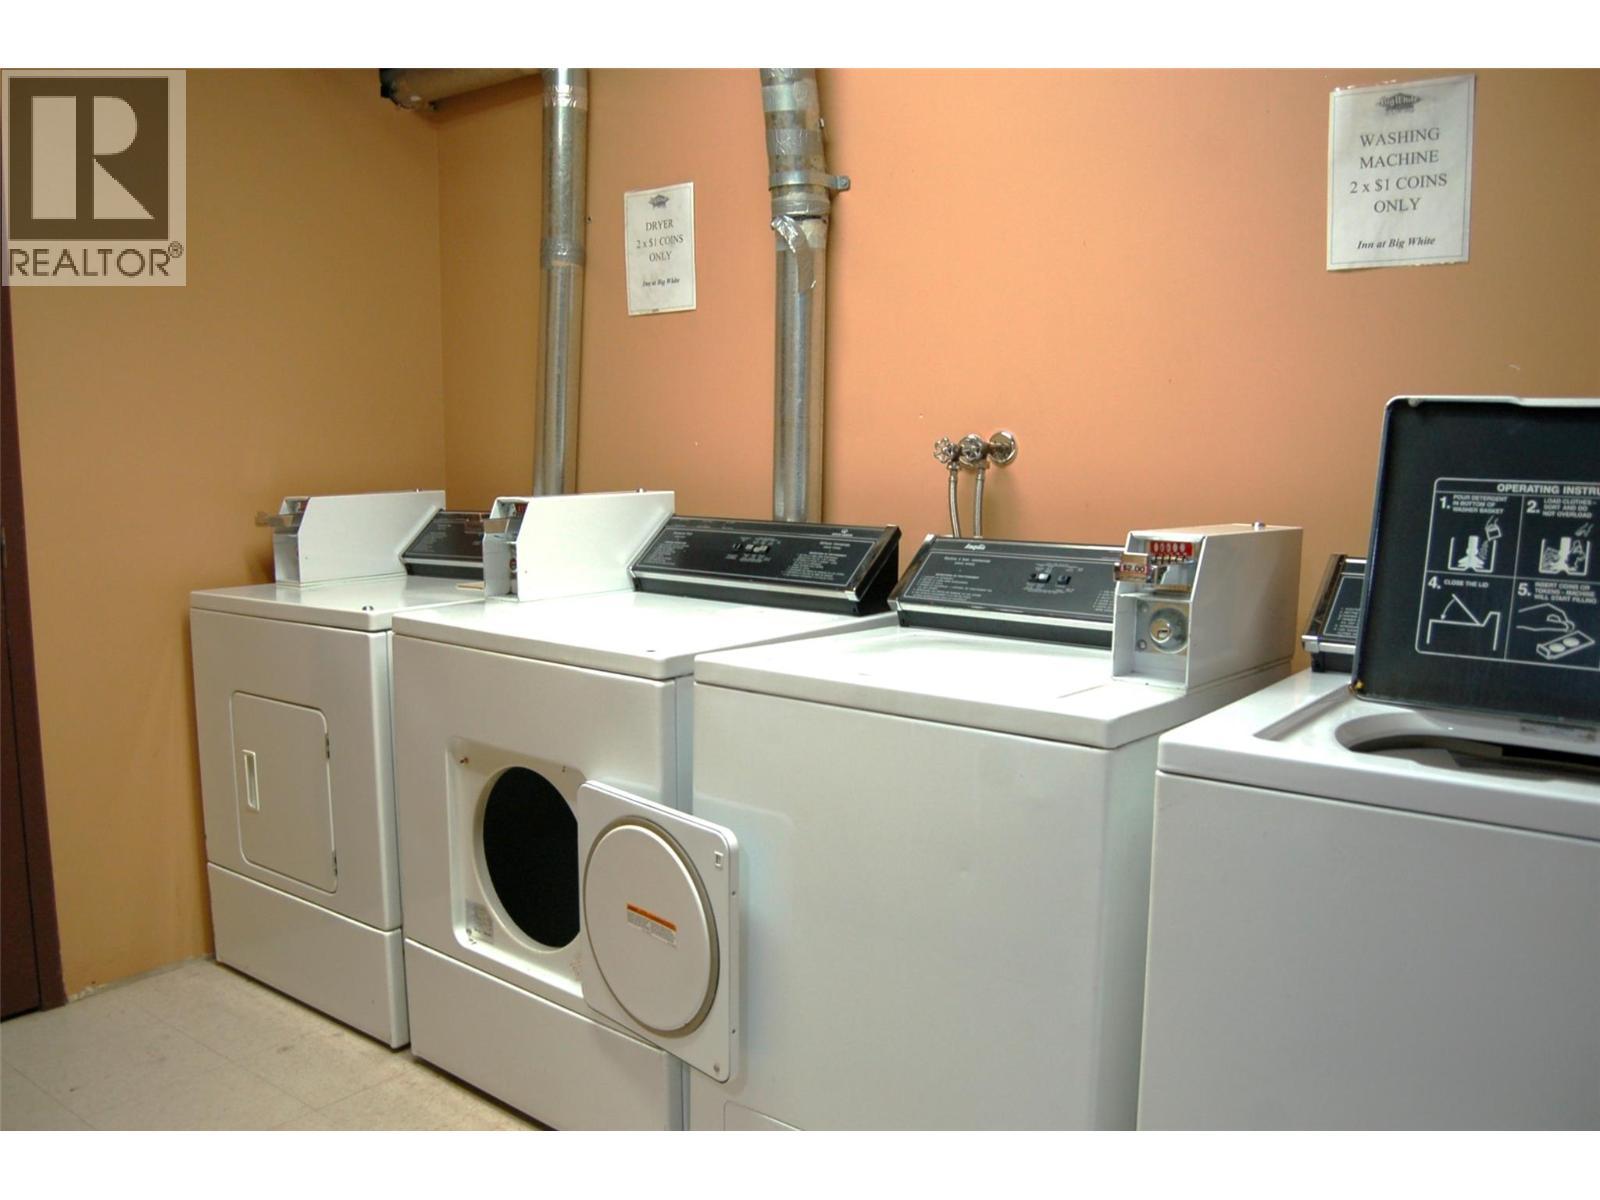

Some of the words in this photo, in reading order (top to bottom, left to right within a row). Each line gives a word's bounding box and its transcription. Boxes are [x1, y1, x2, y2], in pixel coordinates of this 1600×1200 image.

[1359, 127, 1441, 147] WASHING
[1359, 150, 1440, 169] MACHINE
[1349, 181, 1359, 194] 2
[1361, 183, 1370, 193] x
[1374, 178, 1390, 193] $1
[1395, 173, 1448, 190] COINS
[1373, 197, 1422, 213] ONLY
[645, 219, 674, 232] DRYER
[636, 240, 641, 249] 2
[660, 234, 684, 246] COINS
[1357, 239, 1374, 250] Inn
[1376, 240, 1386, 249] at
[1388, 238, 1405, 249] Big
[1407, 236, 1436, 247] White
[649, 251, 672, 262] ONLY
[1496, 483, 1560, 495] OPERATING
[1440, 496, 1451, 509] 1.
[1526, 500, 1540, 513] 2.
[1428, 576, 1441, 589] 4.
[1518, 582, 1531, 596] 5.
